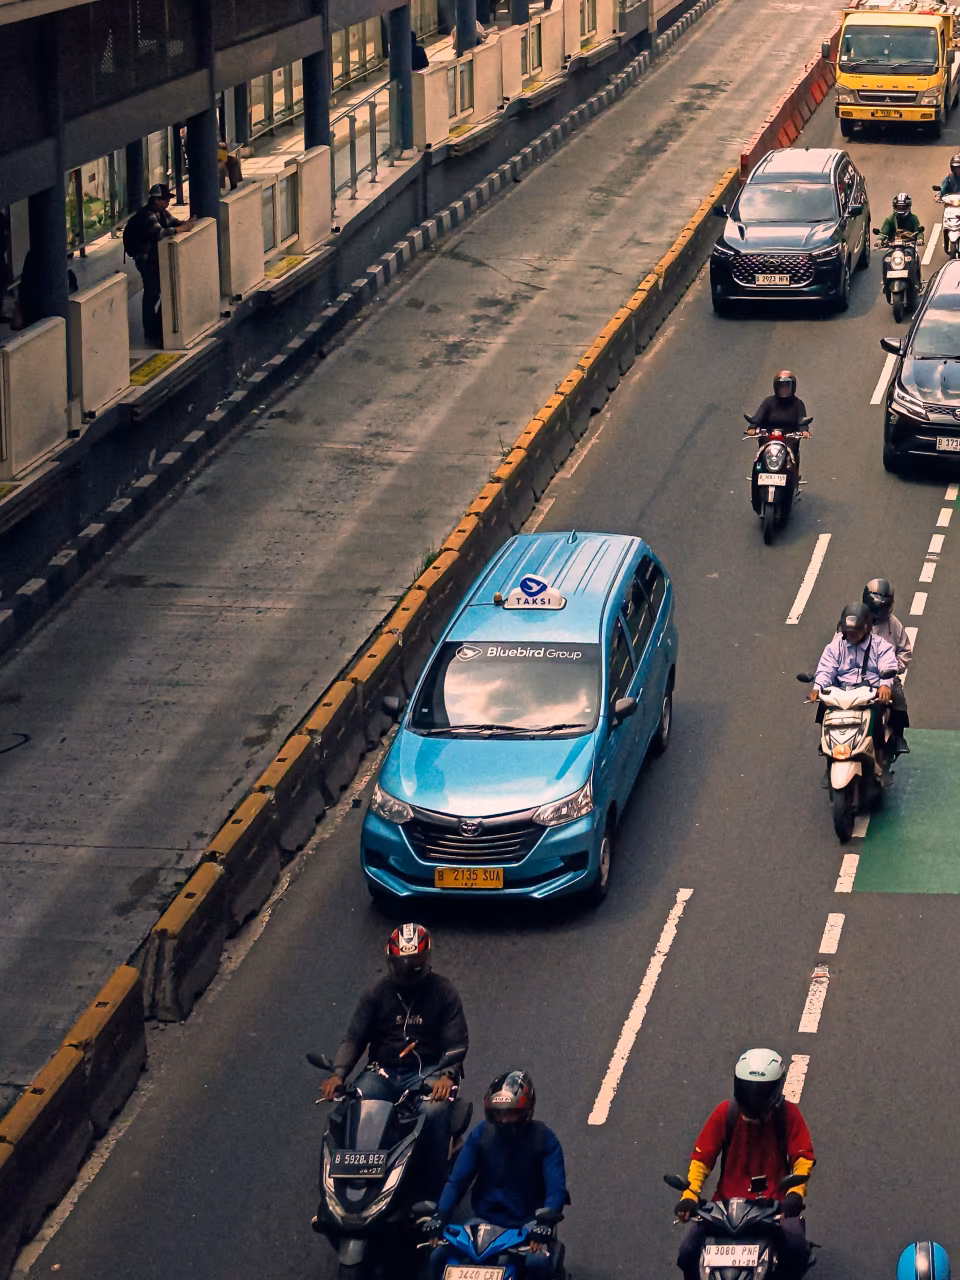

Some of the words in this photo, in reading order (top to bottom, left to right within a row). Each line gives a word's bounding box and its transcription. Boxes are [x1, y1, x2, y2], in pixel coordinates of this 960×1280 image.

[515, 597, 551, 606] TAKSI
[487, 646, 545, 658] Bluebird
[546, 648, 582, 660] Group
[437, 870, 444, 881] B
[453, 869, 478, 881] 2135
[482, 869, 501, 881] SUA
[335, 1154, 341, 1164] B
[344, 1154, 365, 1165] 5928
[368, 1154, 385, 1165] BEZ
[714, 1246, 736, 1256] 3080
[741, 1246, 758, 1256] PNF
